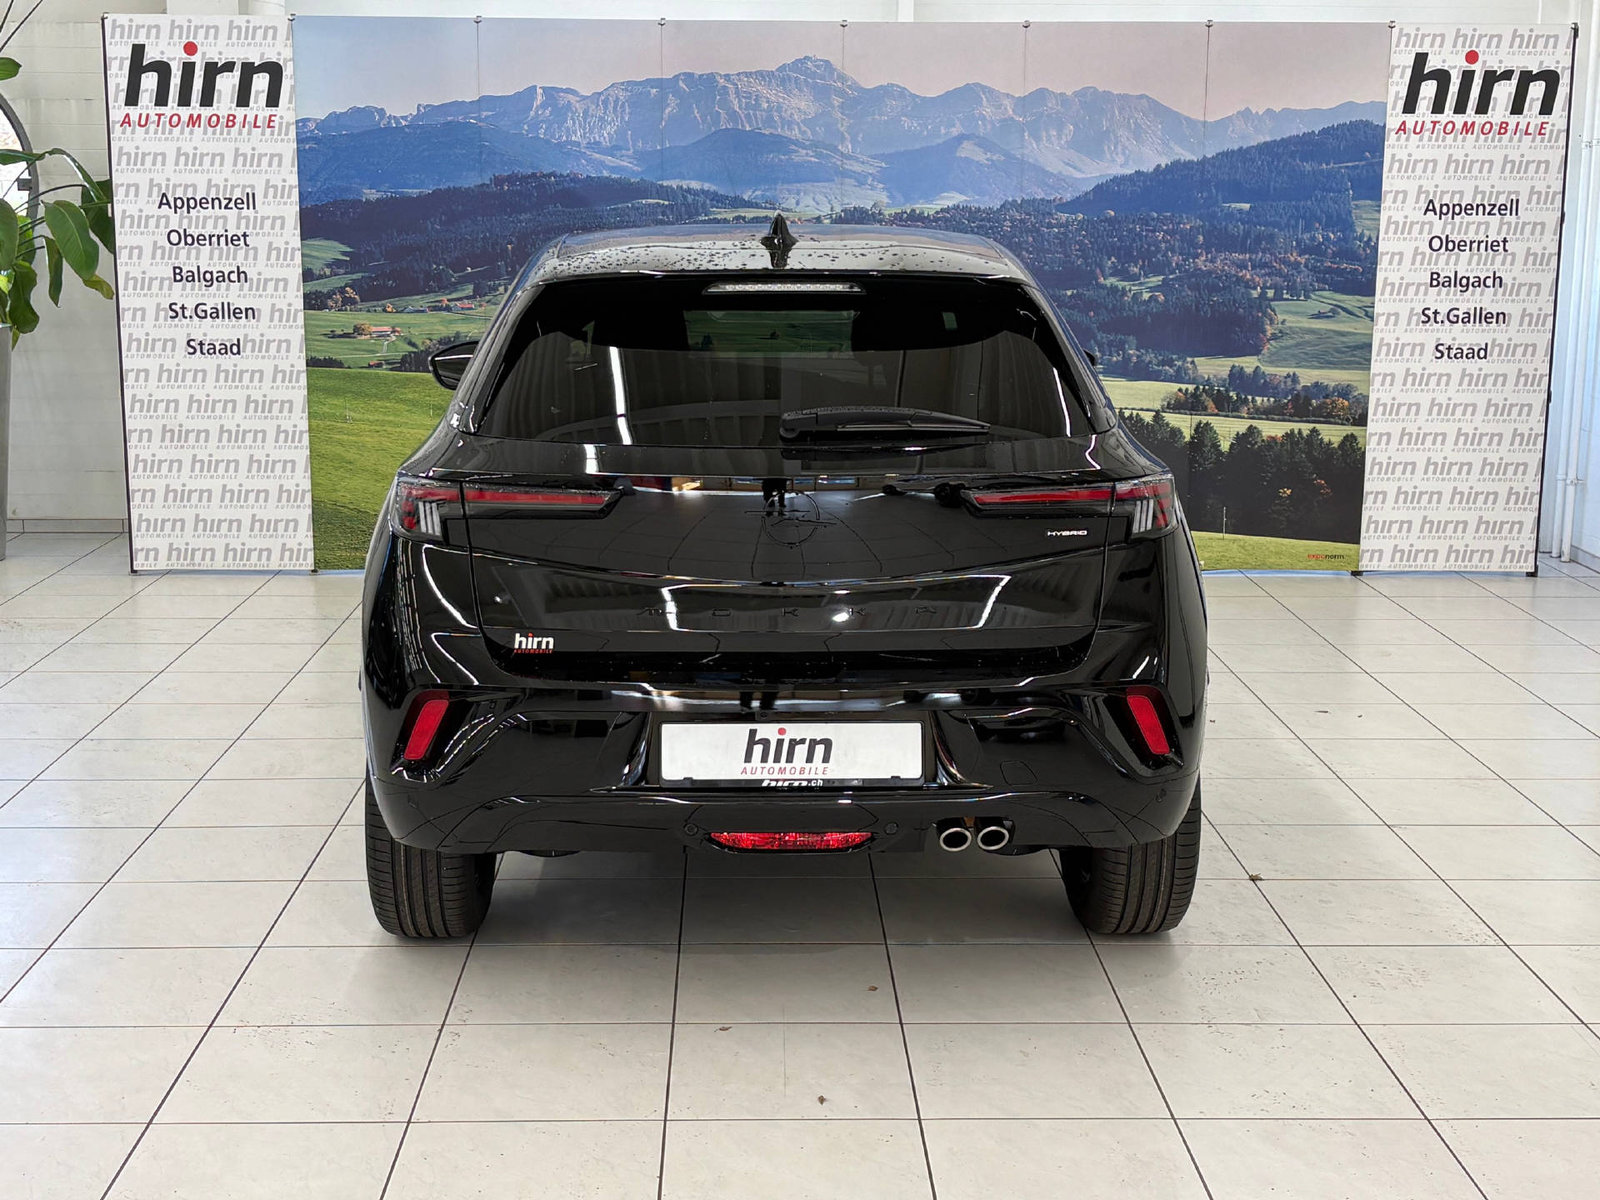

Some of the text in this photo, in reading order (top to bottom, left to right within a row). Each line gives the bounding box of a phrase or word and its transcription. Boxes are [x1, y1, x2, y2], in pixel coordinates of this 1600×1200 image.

[124, 41, 283, 108] hirn
[1402, 50, 1560, 115] hirn
[120, 113, 277, 128] AUTOMOBILE
[1395, 121, 1549, 136] AUTOMOBILE
[116, 146, 283, 168] hirn hirn hirn
[1388, 153, 1551, 175] hirn hirn hirn
[158, 193, 256, 214] Appenzell
[1423, 199, 1519, 220] Appenzell
[167, 229, 249, 247] Oberriet
[1429, 235, 1508, 252] Oberriet
[173, 266, 248, 287] Balgach
[1430, 271, 1503, 292] Balgach
[168, 302, 256, 320] St.Gallen
[1421, 307, 1506, 325] St.Gallen
[126, 332, 176, 352] hirn
[187, 338, 241, 356] Staad
[1376, 337, 1425, 357] hirn
[1435, 343, 1488, 360] Staad
[157, 363, 264, 383] hirn hirn
[1402, 367, 1507, 387] hirn hirn
[130, 393, 294, 414] hirn hirn hirn
[1373, 397, 1532, 417] hirn hirn hirn
[160, 424, 267, 444] hirn hirn
[1398, 427, 1503, 447] hirn hirn
[133, 453, 296, 474] hirn hirn hirn
[1369, 456, 1528, 476] hirn hirn hirn
[163, 483, 269, 503] hirn hirn
[1394, 486, 1498, 505] hirn hirn
[136, 513, 299, 533] hirn hirn hirn
[1366, 515, 1523, 534] hirn hirn hirn
[167, 542, 272, 562] hirn hirn
[1390, 544, 1494, 564] hirn hirn
[514, 633, 554, 649] hirn
[744, 728, 832, 764] hirn
[741, 767, 828, 775] AUTOMOBILE
